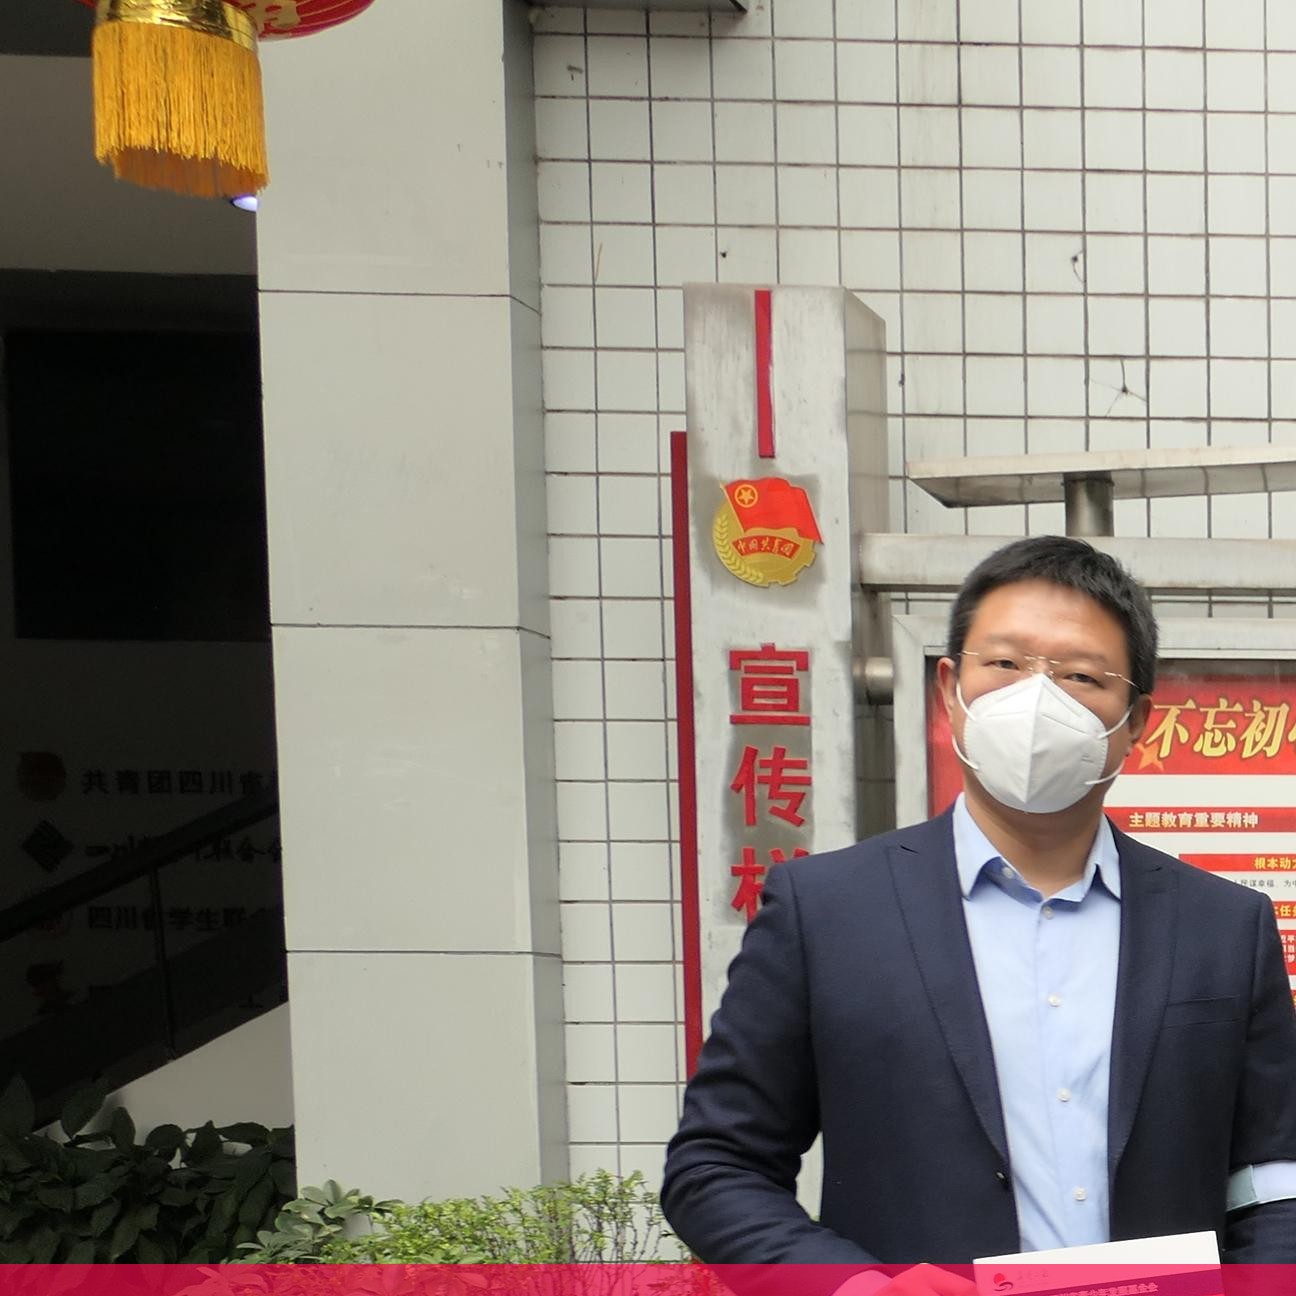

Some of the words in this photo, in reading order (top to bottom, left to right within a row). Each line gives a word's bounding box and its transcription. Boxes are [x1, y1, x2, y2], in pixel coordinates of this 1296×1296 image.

[82, 769, 279, 796] 共青团四川省
[1129, 812, 1259, 828] 主题教育重要精神
